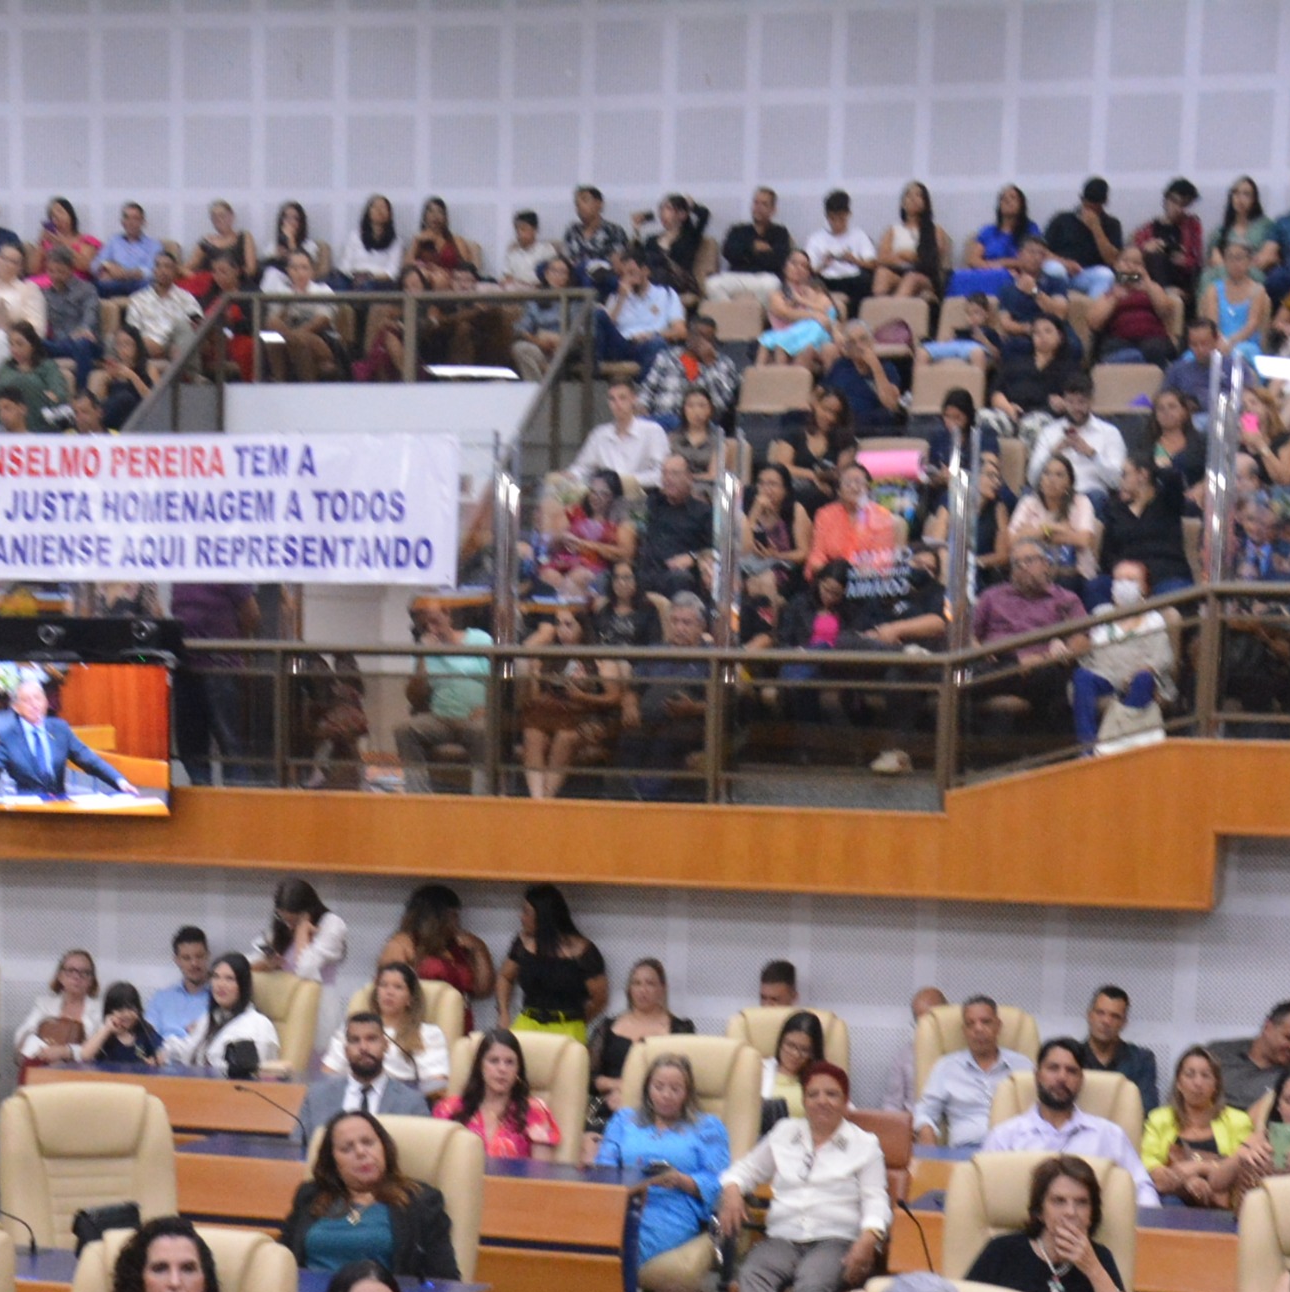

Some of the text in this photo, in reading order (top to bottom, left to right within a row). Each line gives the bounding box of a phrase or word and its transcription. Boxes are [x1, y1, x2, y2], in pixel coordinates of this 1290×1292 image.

[110, 446, 226, 477] PEREIRA
[234, 445, 289, 477] TEM
[298, 444, 317, 477] A
[4, 489, 92, 522] JUSTA
[102, 490, 276, 522] HOMENAGEM
[284, 490, 303, 522] A
[312, 490, 406, 523] TODOS
[120, 535, 185, 568] AQUI
[196, 535, 434, 569] REPRESENTANDO
